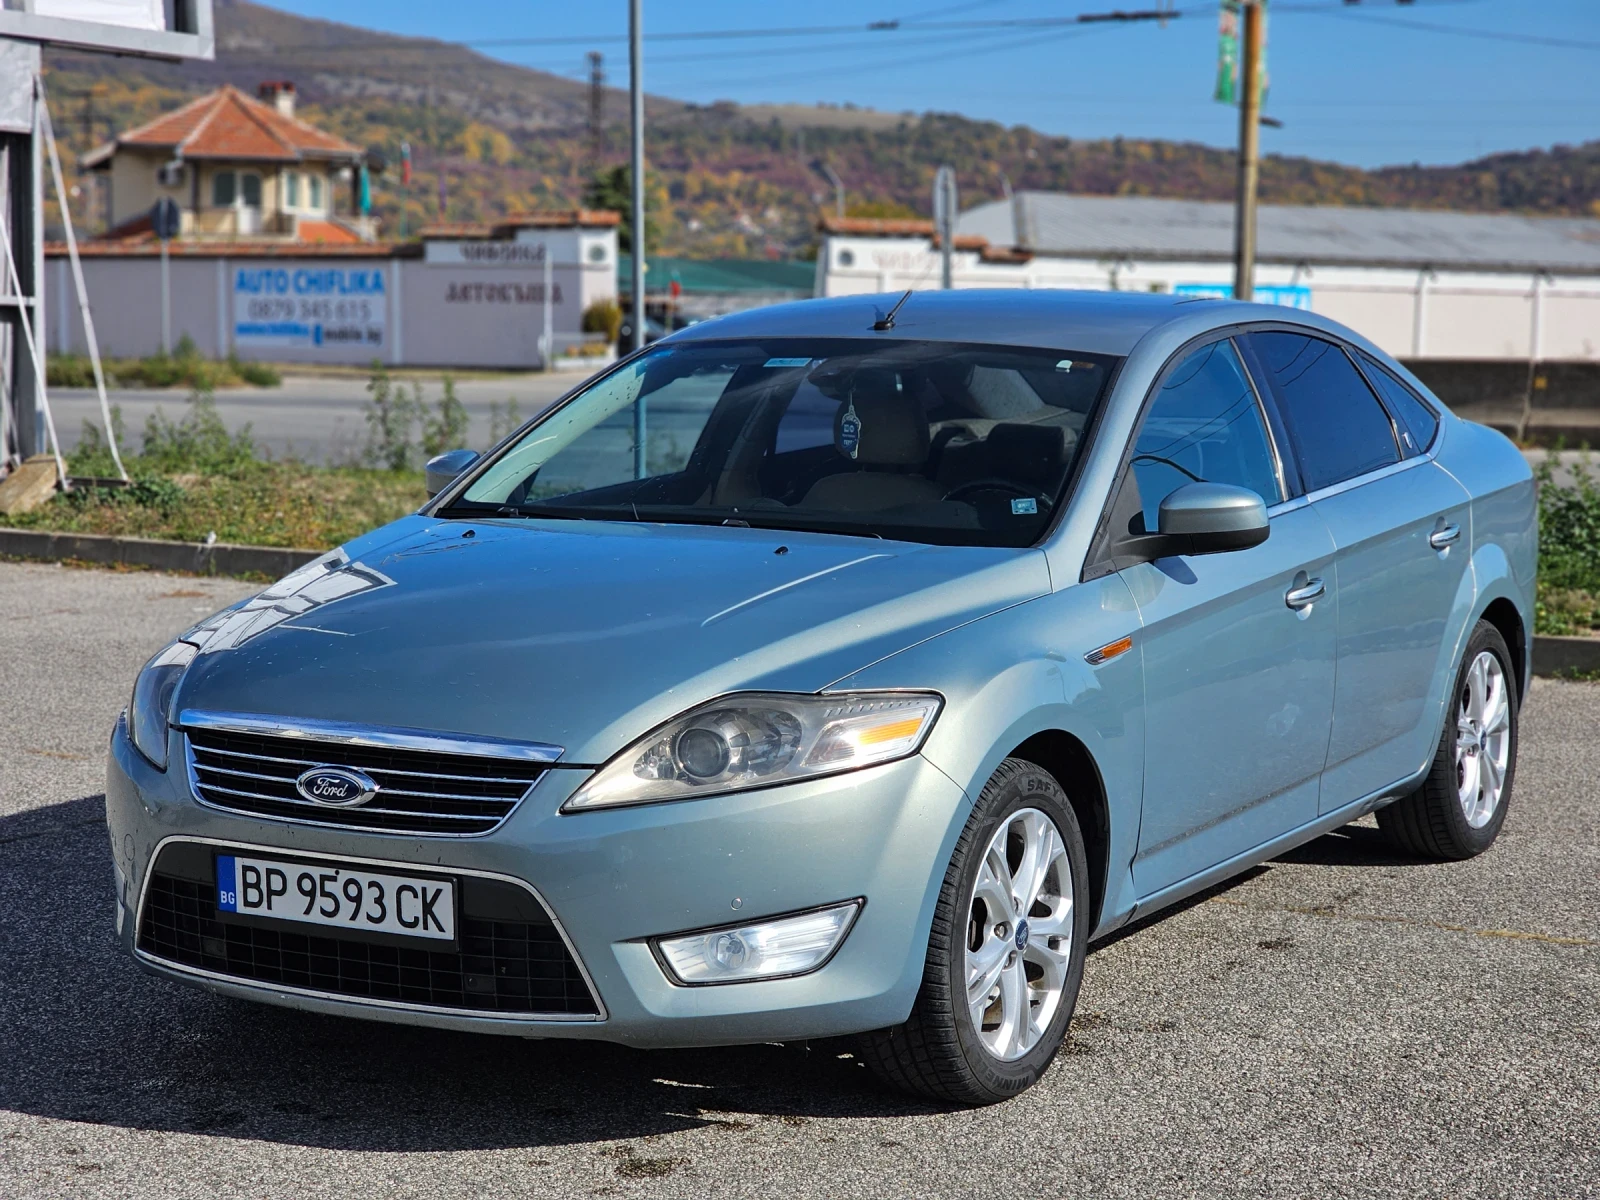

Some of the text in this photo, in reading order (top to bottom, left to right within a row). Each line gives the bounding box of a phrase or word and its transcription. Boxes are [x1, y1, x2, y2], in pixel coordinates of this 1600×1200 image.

[236, 269, 384, 293] AUTO CHIFLIKA
[313, 777, 349, 797] Ford
[220, 890, 235, 905] BG
[241, 864, 446, 933] BP 9593 CK
